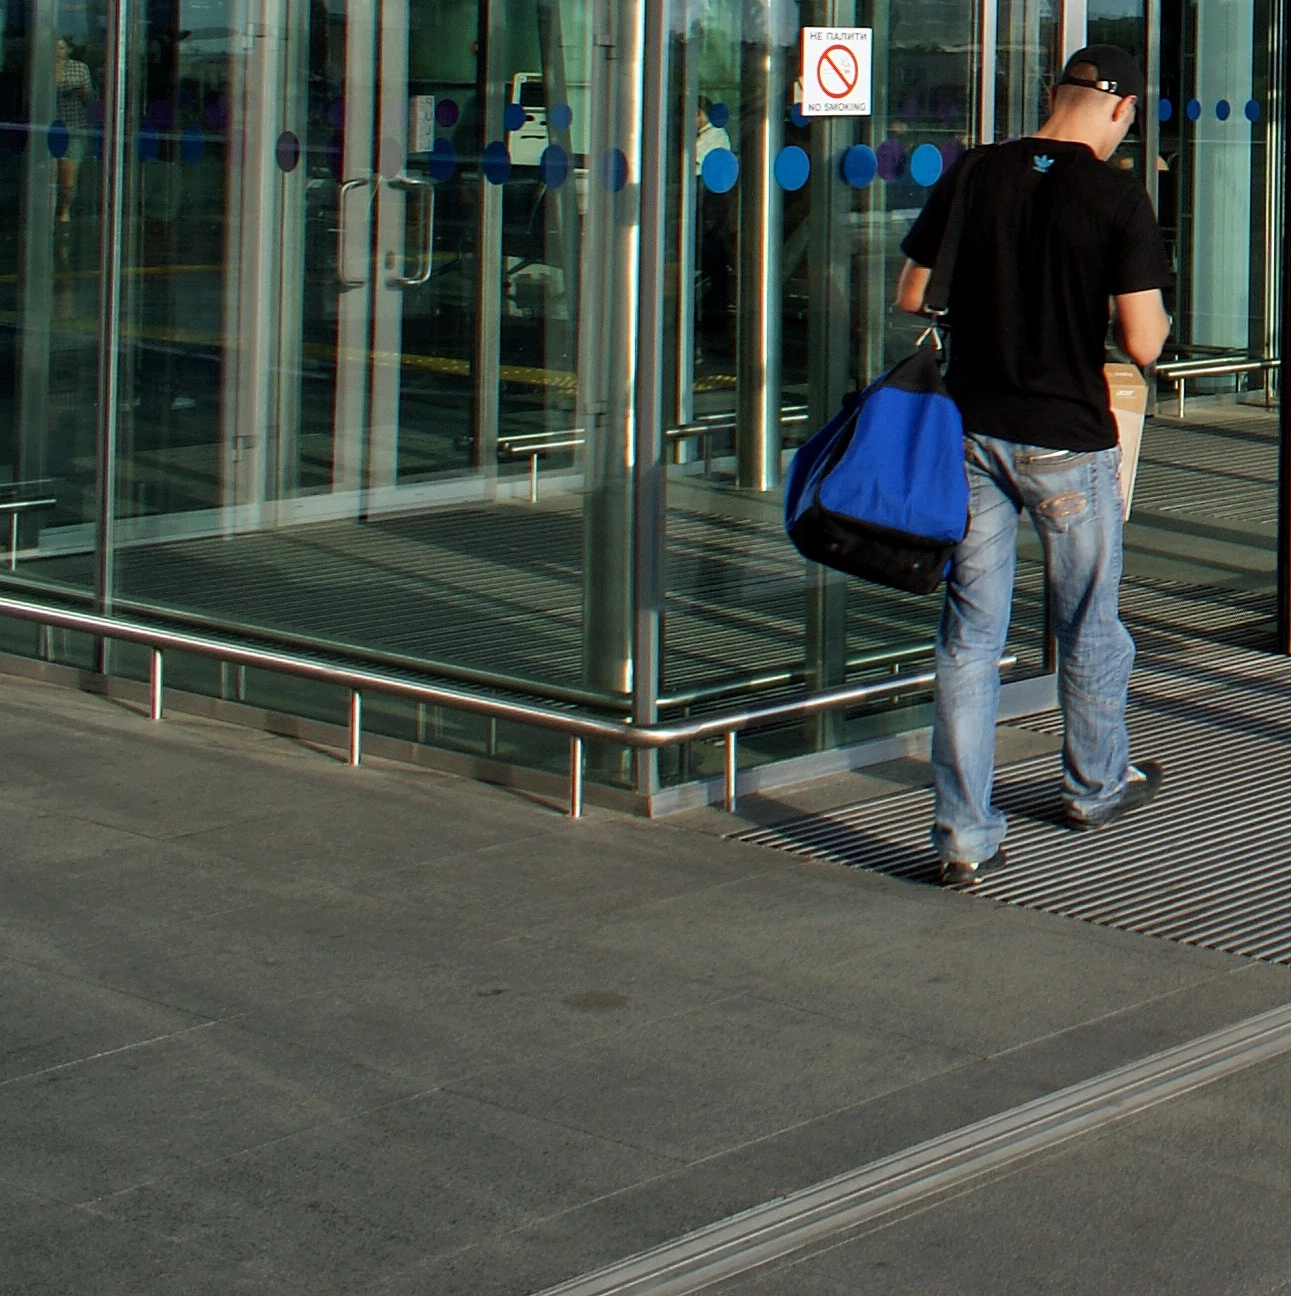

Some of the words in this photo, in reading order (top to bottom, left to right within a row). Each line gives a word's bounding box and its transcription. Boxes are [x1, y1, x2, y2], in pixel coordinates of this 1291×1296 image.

[810, 32, 823, 40] НЕ
[826, 32, 867, 41] ПАЛИТИ
[808, 103, 821, 112] NO
[824, 103, 866, 112] SMOKING
